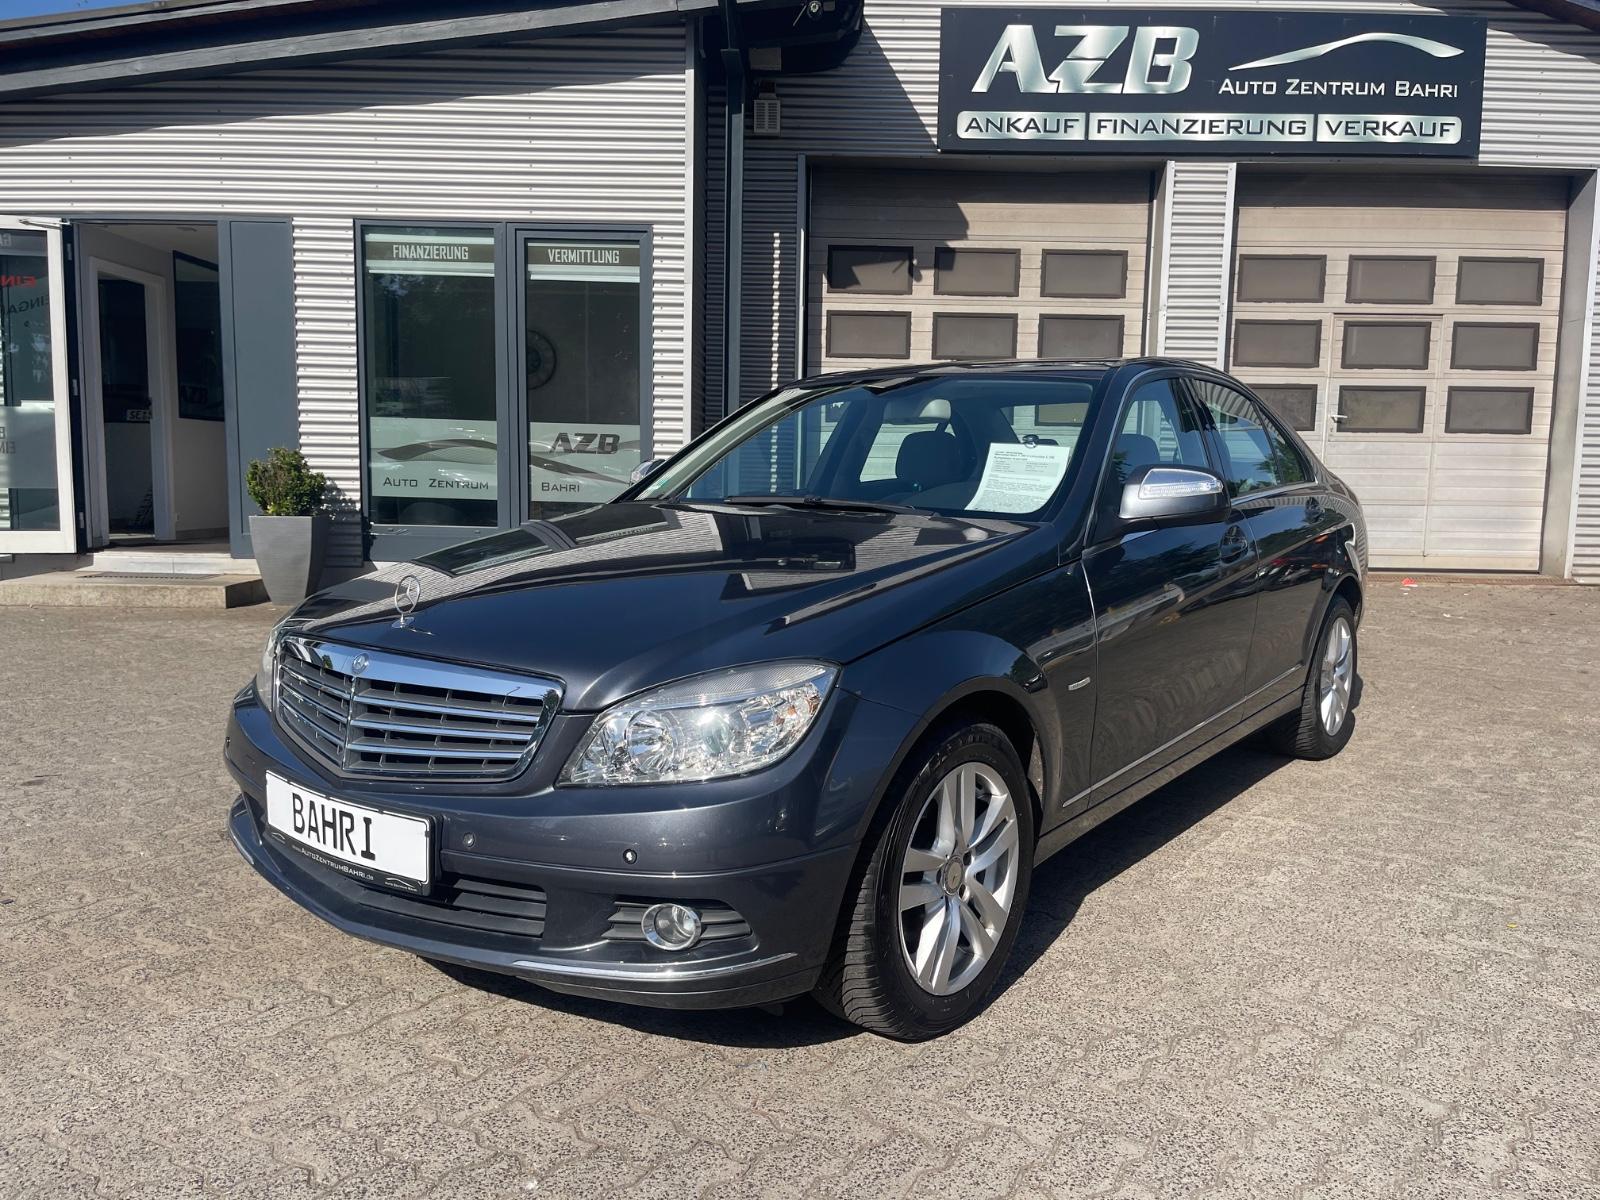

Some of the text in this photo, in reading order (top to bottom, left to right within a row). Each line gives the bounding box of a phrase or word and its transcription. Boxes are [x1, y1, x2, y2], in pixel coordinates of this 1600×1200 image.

[971, 24, 1200, 95] AZB
[964, 116, 1456, 138] ANKAUF FINANZIERUNG VERKAUF
[392, 244, 469, 261] FINANZIERUNG
[547, 248, 620, 264] VERMITTLUNG
[549, 432, 621, 455] AZB
[292, 792, 376, 861] BAHRI
